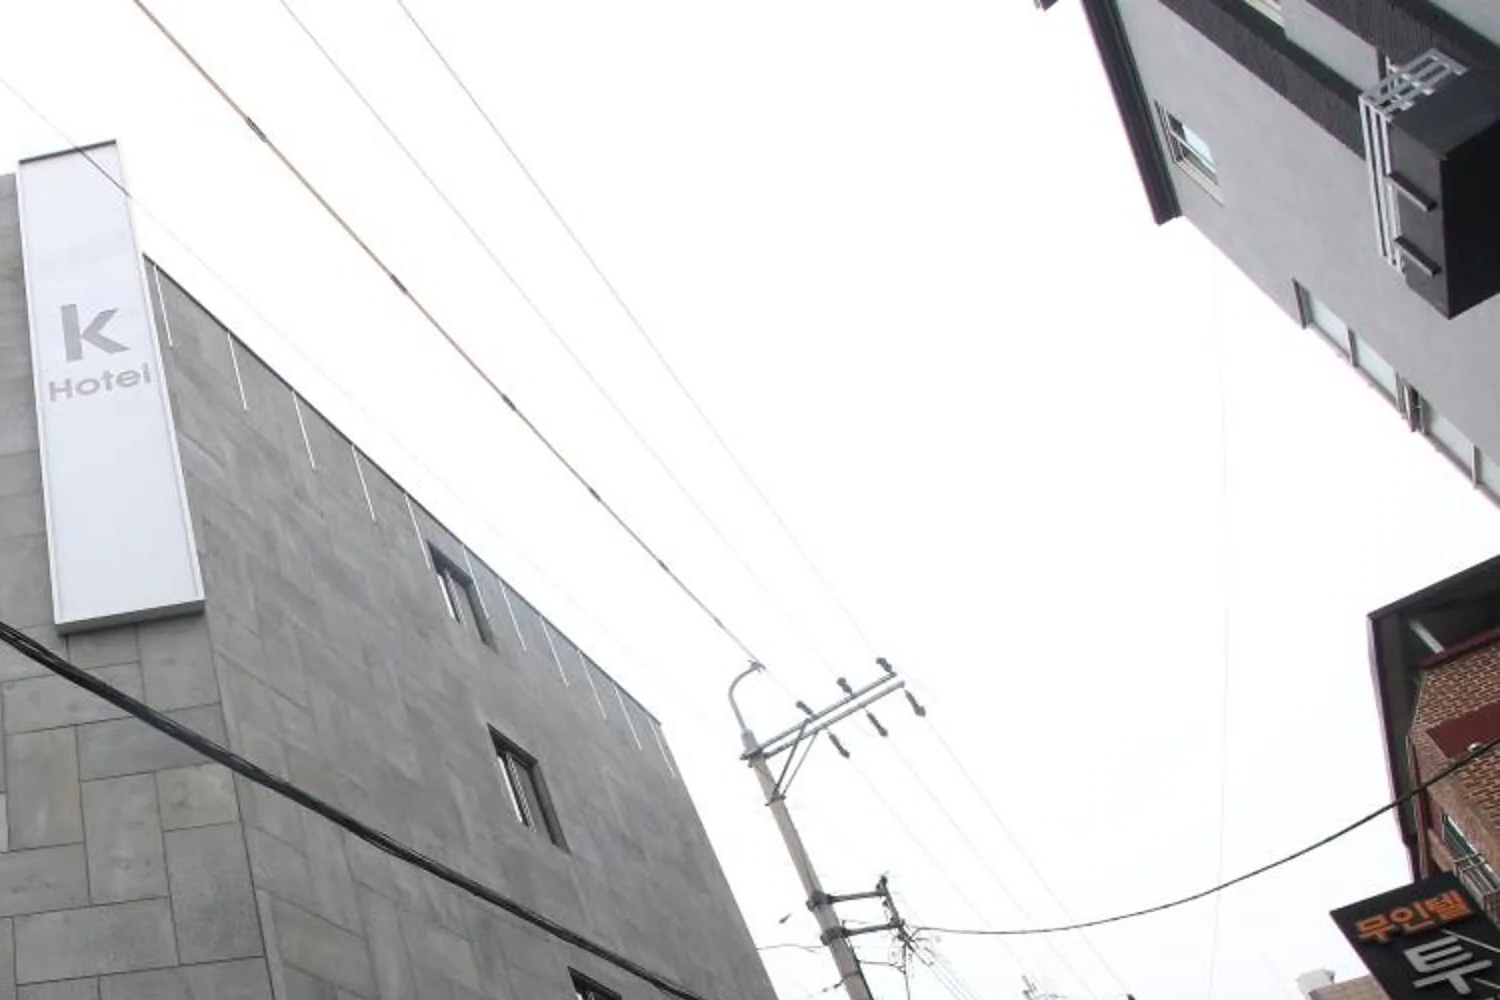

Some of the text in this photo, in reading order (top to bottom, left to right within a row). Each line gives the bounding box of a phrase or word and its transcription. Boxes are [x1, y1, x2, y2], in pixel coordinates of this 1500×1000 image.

[60, 303, 130, 363] K
[48, 362, 151, 402] Hotel
[1355, 890, 1472, 944] 무인텔
